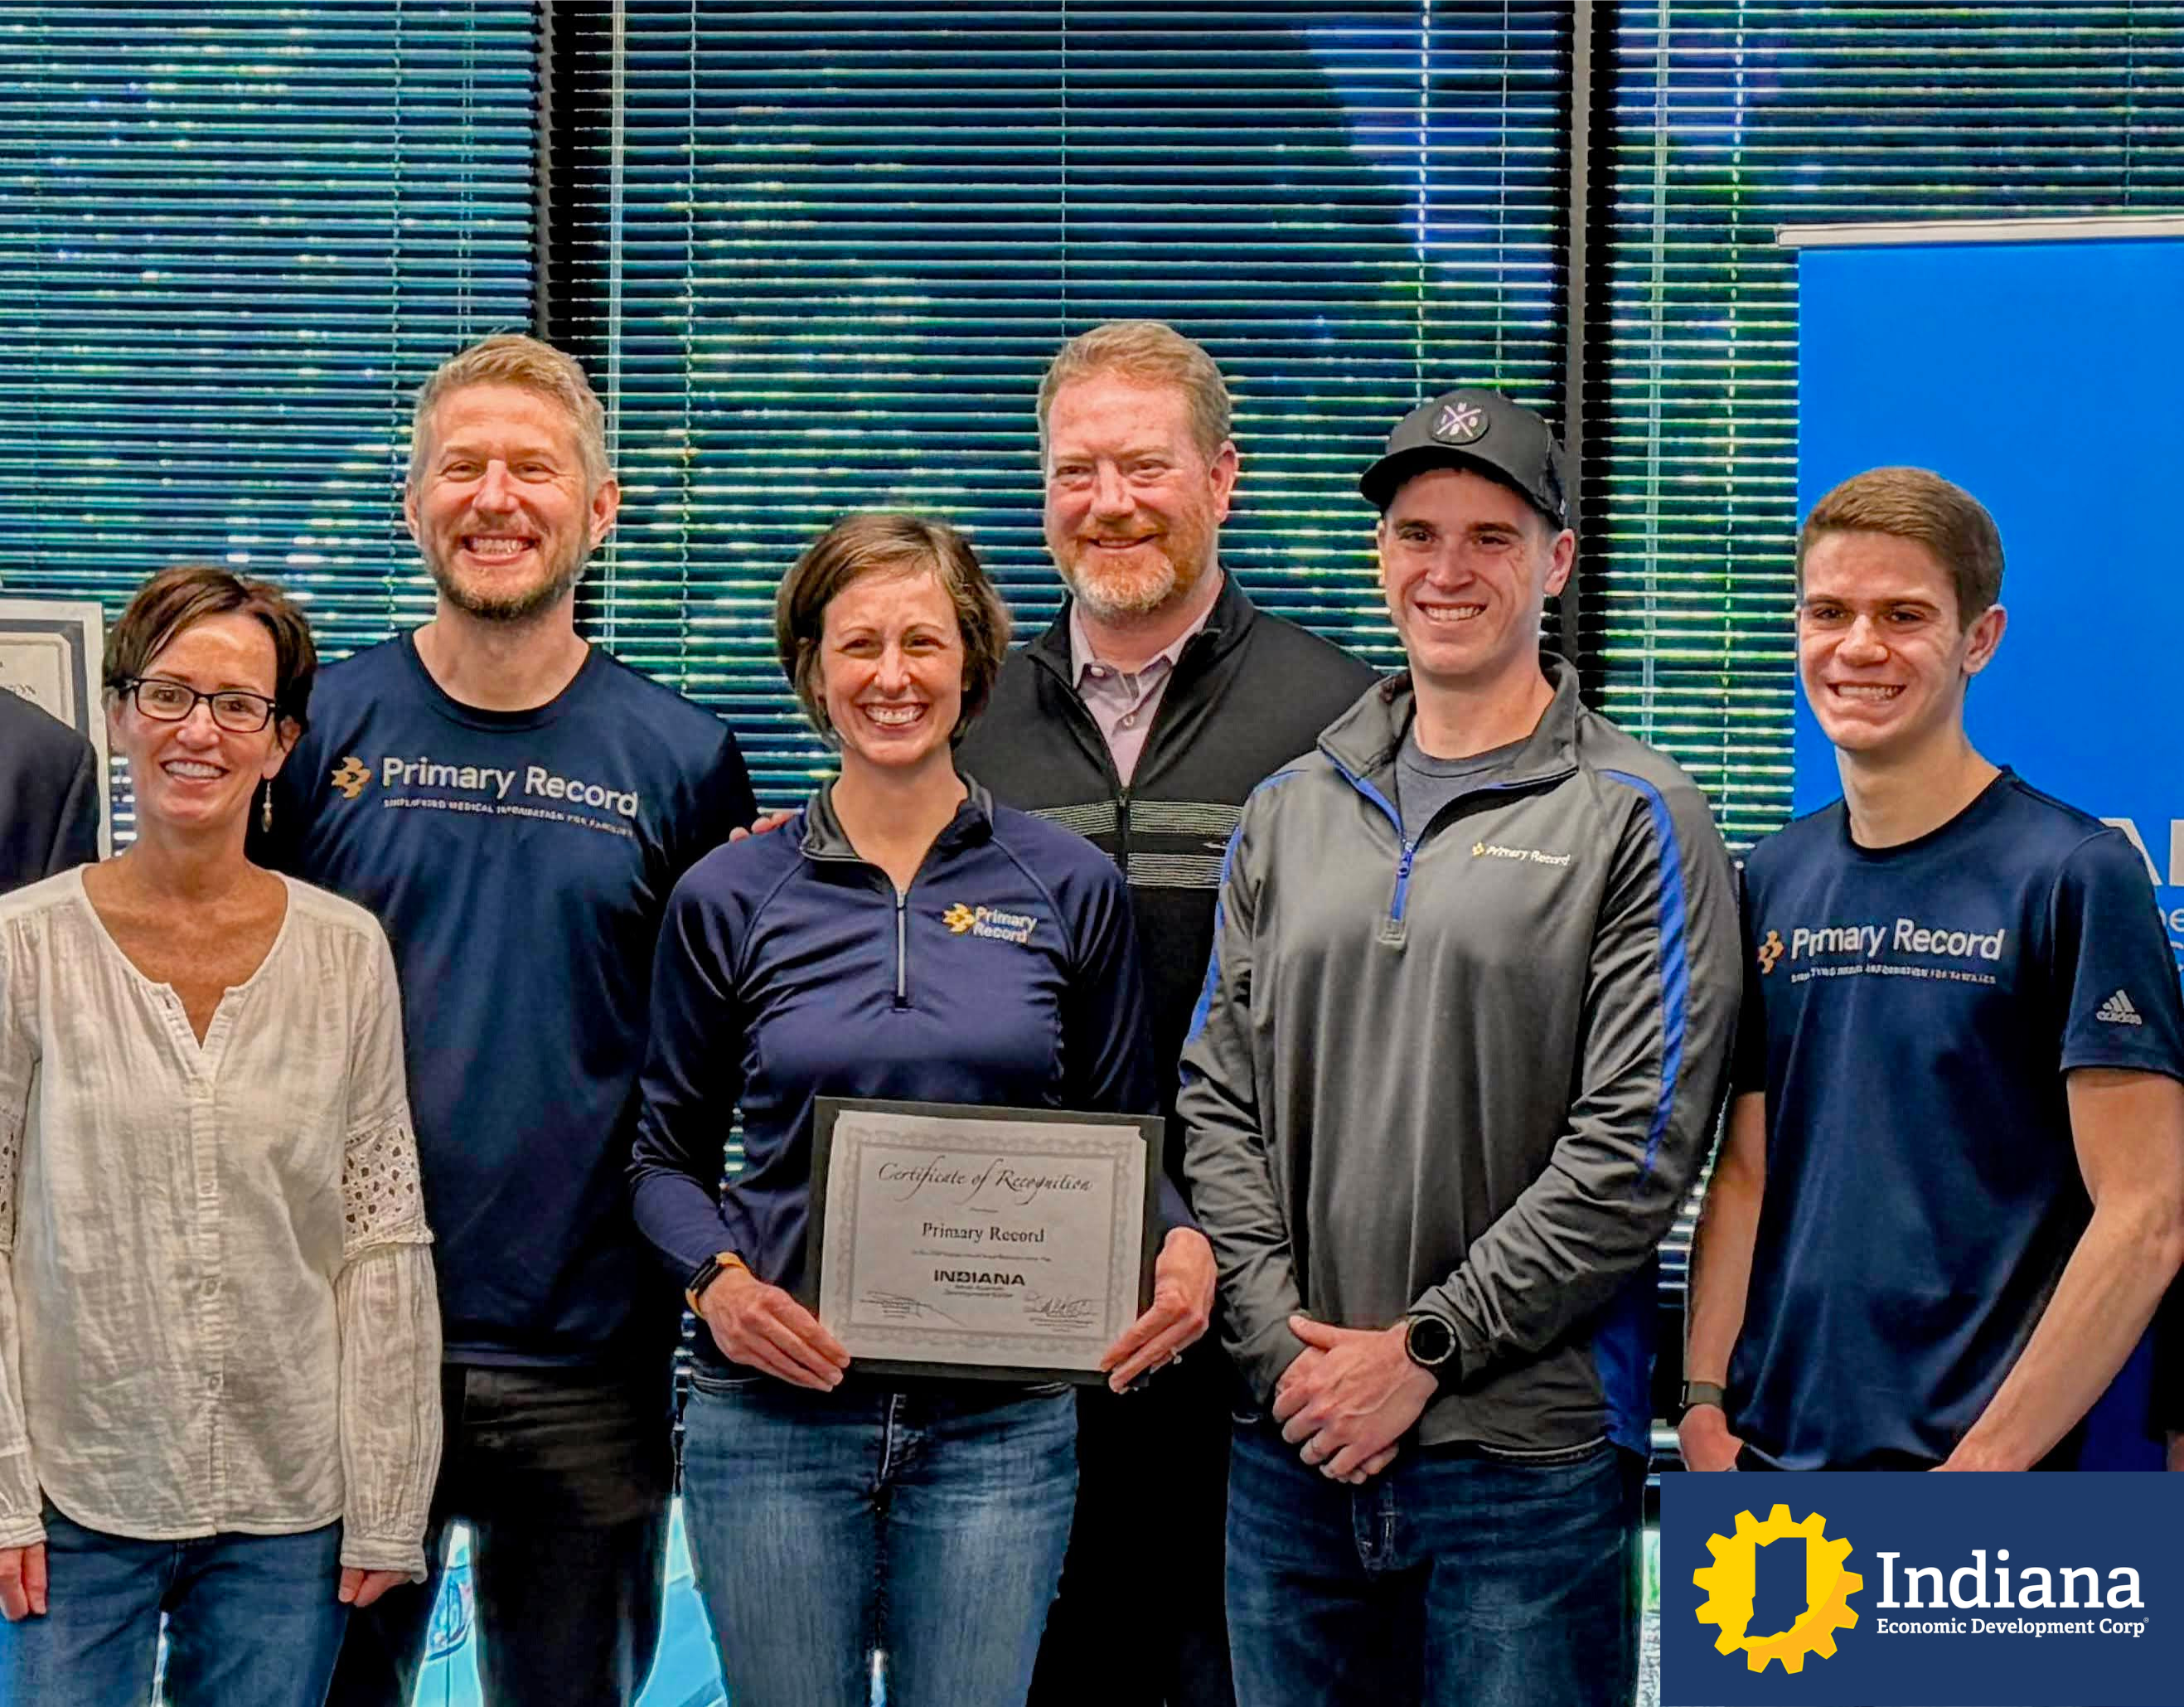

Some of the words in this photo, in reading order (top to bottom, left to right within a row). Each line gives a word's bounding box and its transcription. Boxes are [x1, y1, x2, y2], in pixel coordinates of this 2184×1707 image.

[382, 756, 516, 800] Primary
[525, 765, 638, 817] Record
[1486, 846, 1528, 861] Primary
[1530, 851, 1571, 866] Record
[975, 905, 1038, 934] Primary
[973, 922, 1028, 943] Record
[1791, 924, 1886, 960] Prmary
[1893, 918, 2004, 961] Record
[2096, 1010, 2143, 1025] adidas
[879, 1155, 967, 1202] Certificate
[996, 1168, 1092, 1205] Recognition
[922, 1222, 982, 1244] Primary
[990, 1225, 1045, 1243] Record
[933, 1268, 1026, 1287] INDIANA
